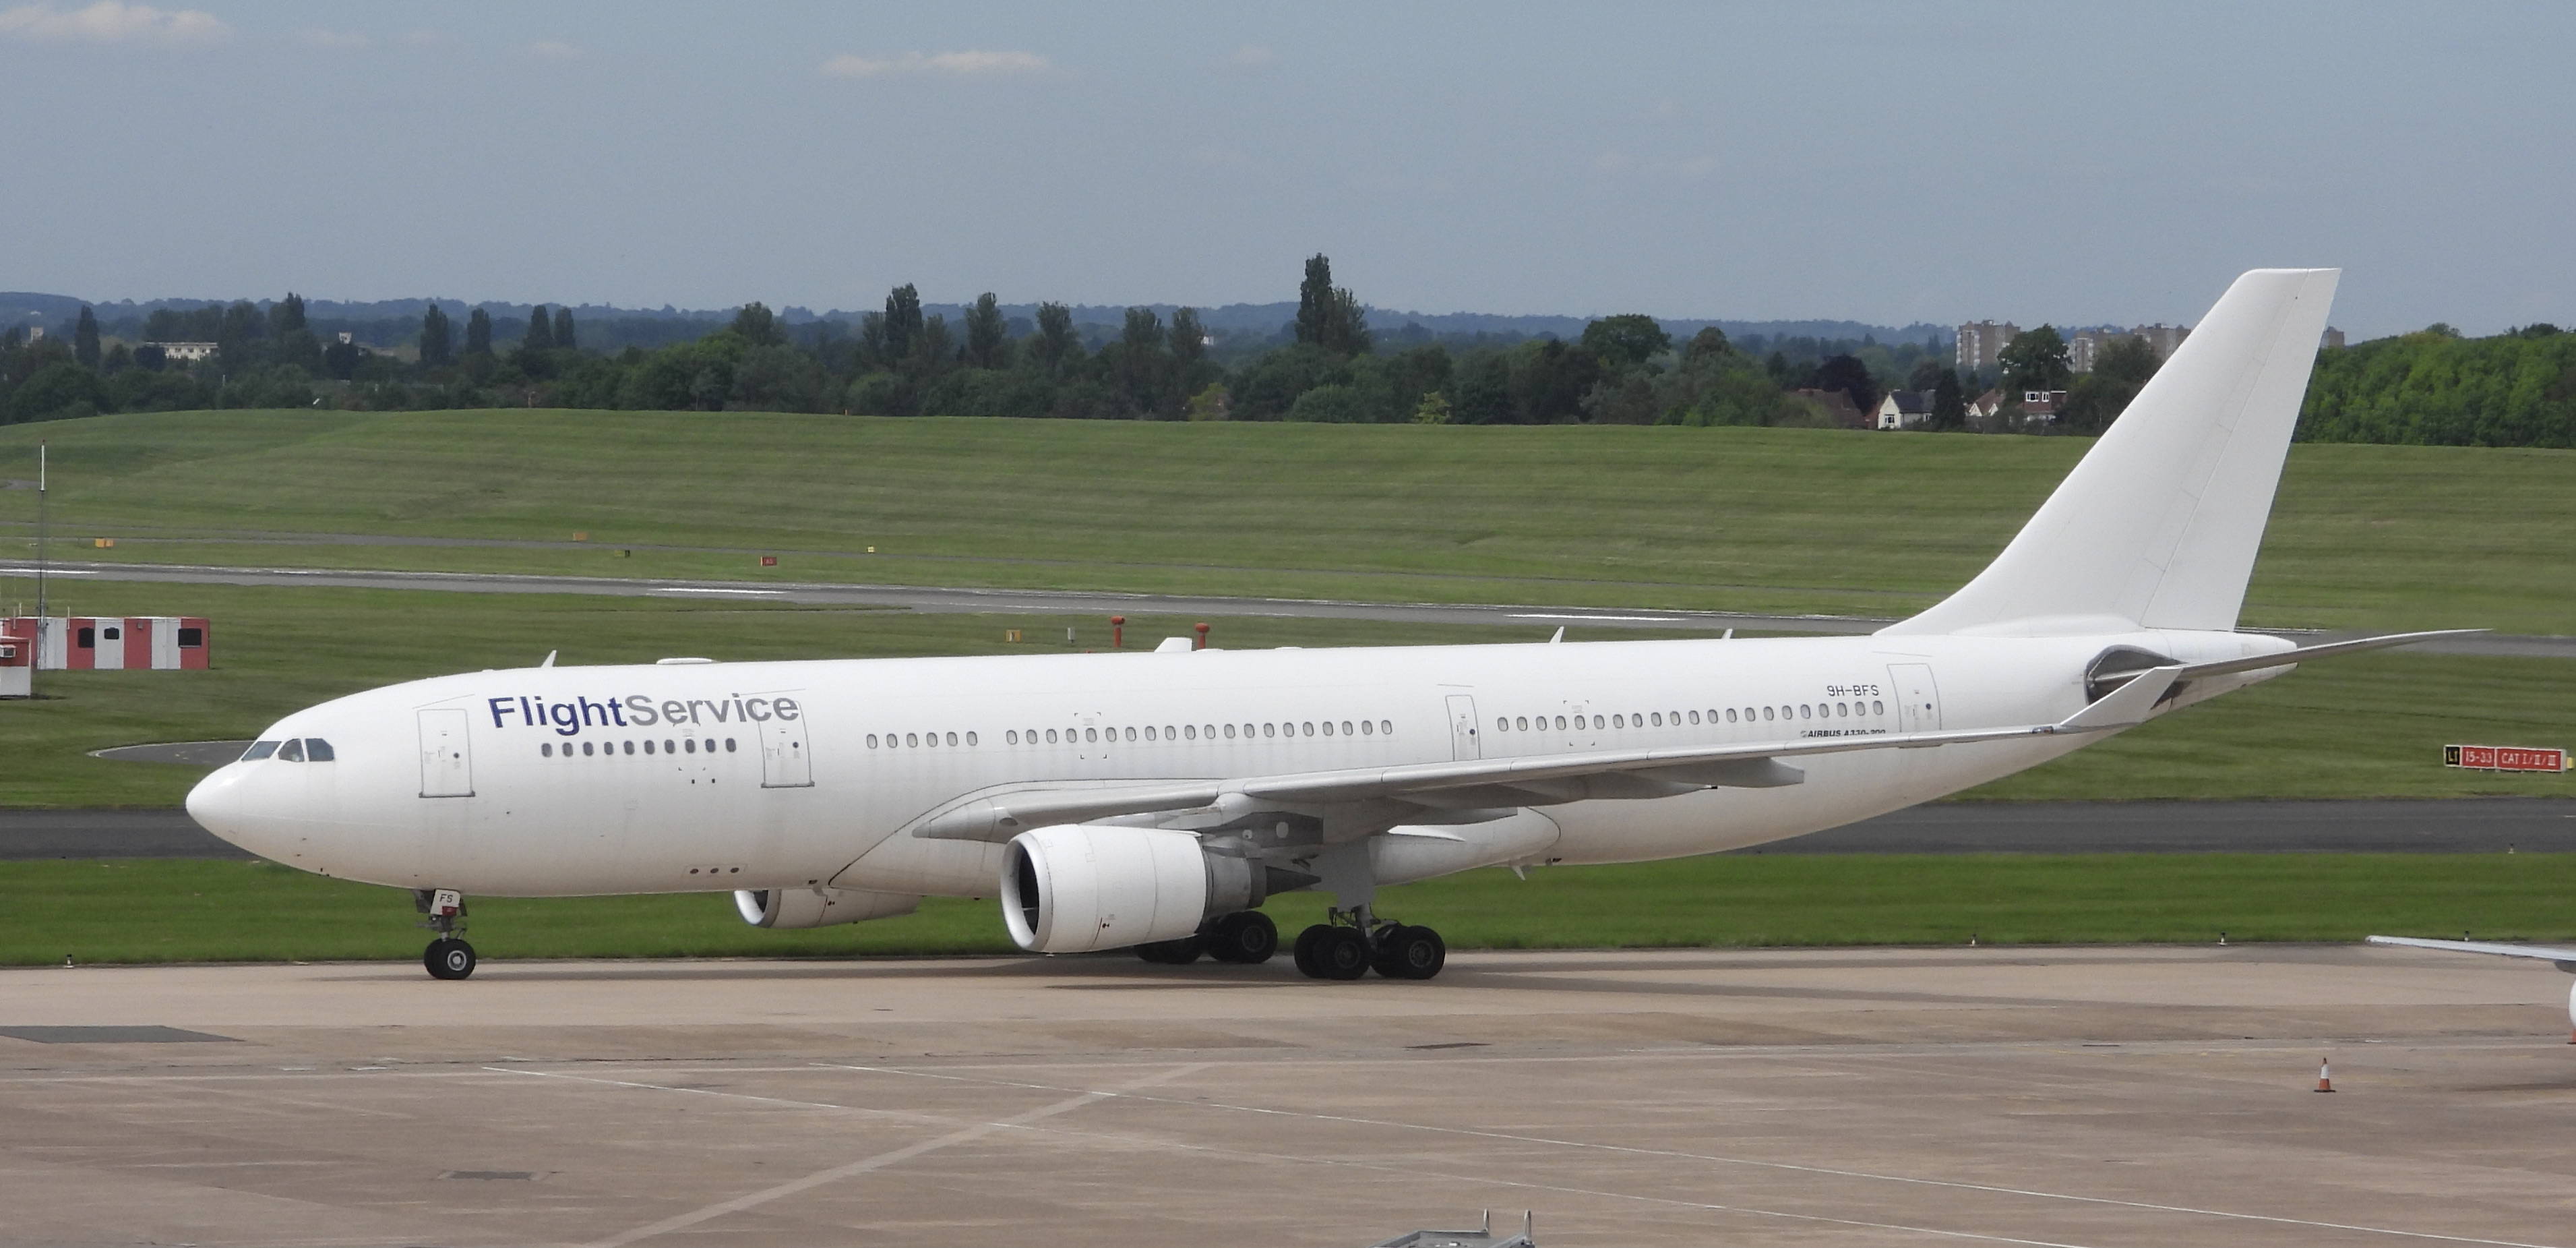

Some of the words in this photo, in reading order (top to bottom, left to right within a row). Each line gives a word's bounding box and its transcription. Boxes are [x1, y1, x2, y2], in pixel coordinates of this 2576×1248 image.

[1827, 685, 1878, 696] 9H-BFS
[488, 692, 799, 736] FlightService
[2465, 750, 2492, 763] 15-33
[2502, 752, 2519, 765] CAT
[439, 893, 453, 902] FS
